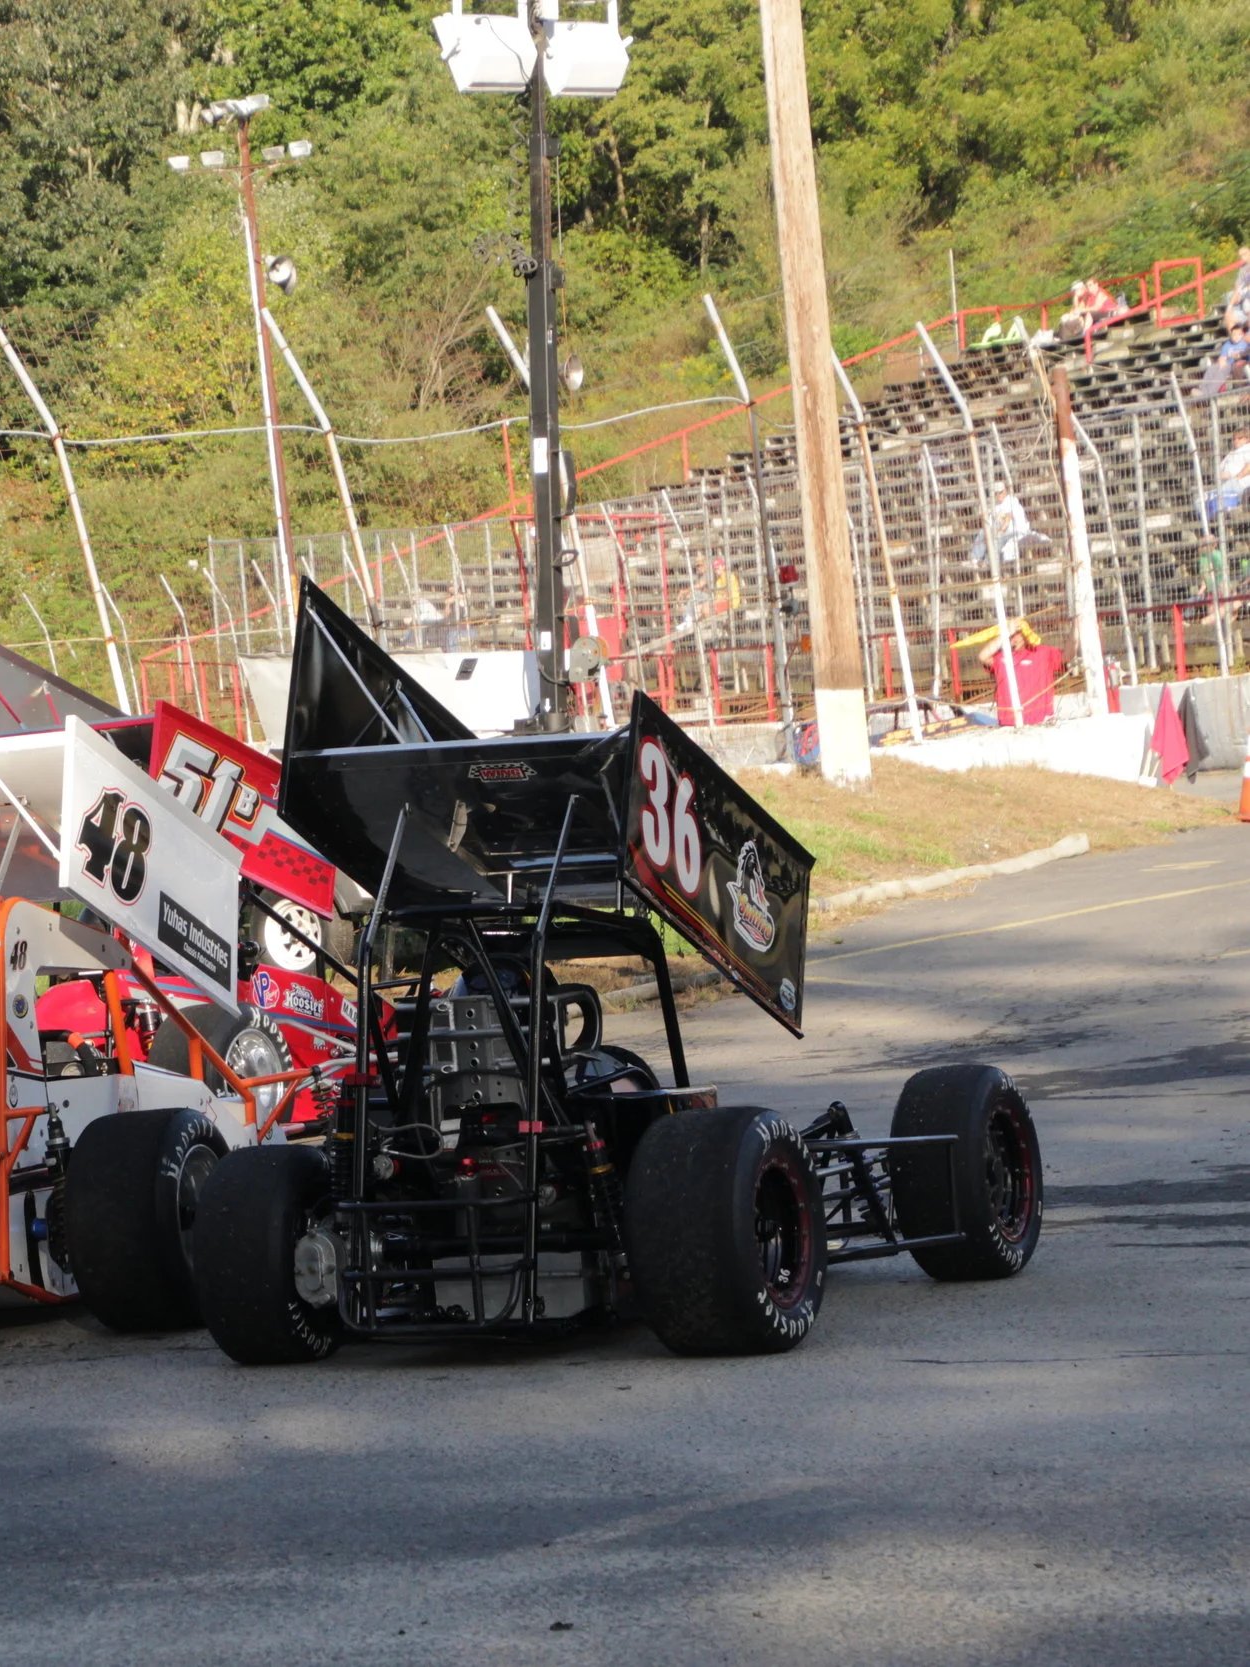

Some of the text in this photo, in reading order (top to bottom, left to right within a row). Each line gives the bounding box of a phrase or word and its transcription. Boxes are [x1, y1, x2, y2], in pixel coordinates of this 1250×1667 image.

[75, 788, 152, 904] 48
[640, 738, 701, 896] 36
[11, 940, 28, 971] 48
[162, 901, 229, 969] Yuhas Industries
[252, 972, 270, 1008] VP
